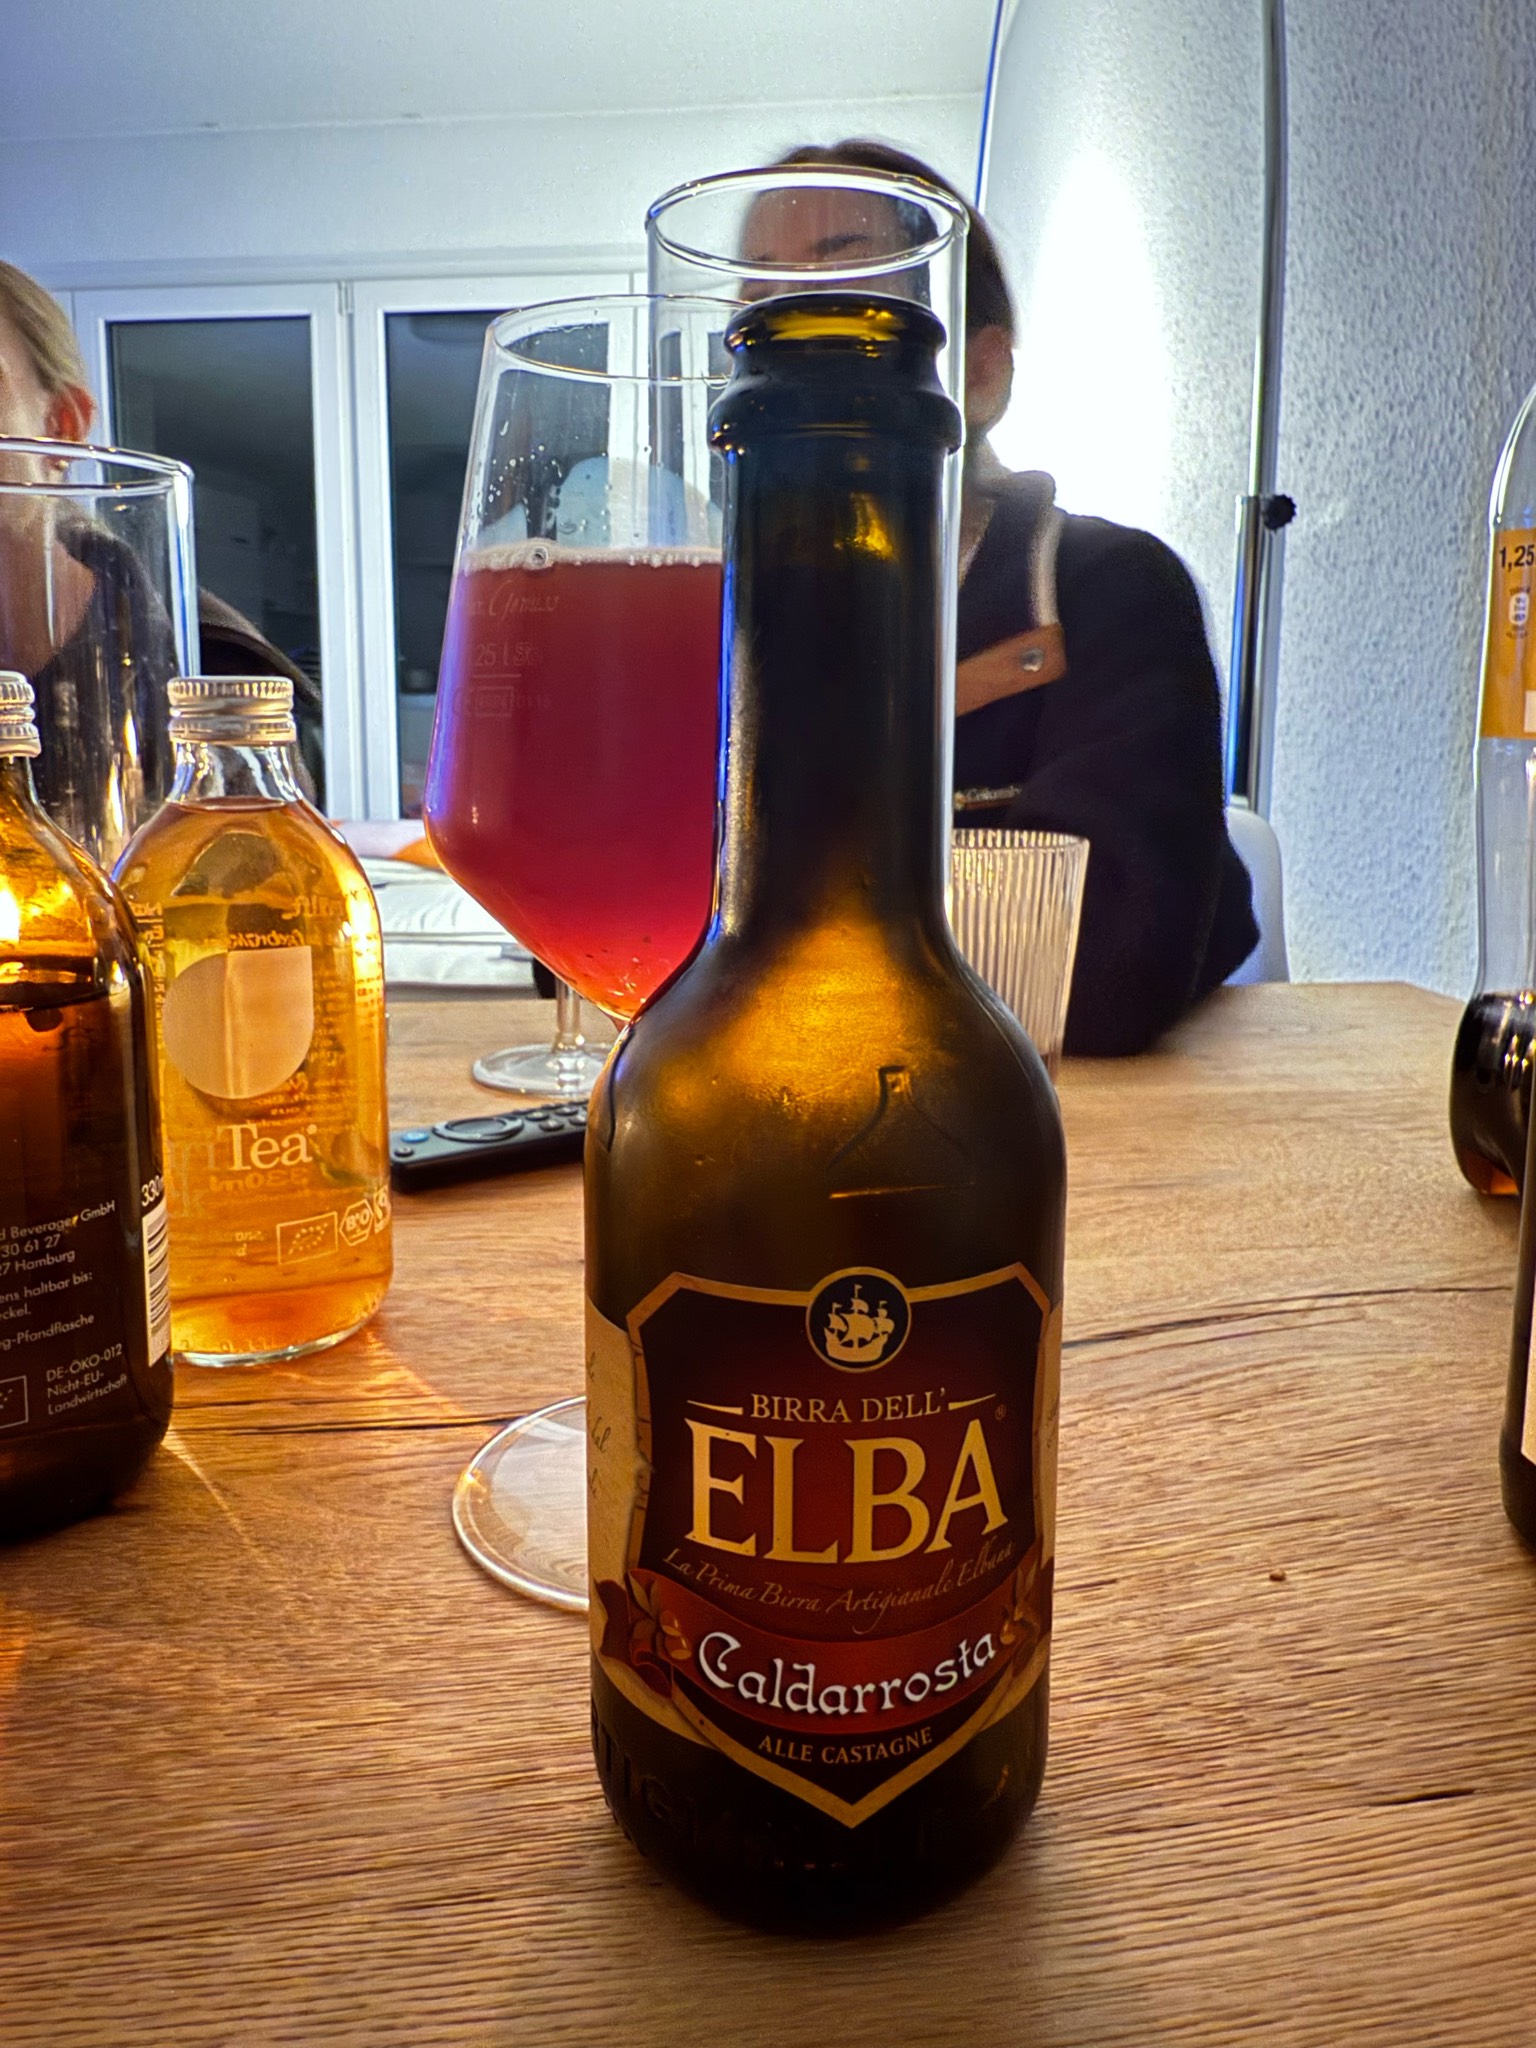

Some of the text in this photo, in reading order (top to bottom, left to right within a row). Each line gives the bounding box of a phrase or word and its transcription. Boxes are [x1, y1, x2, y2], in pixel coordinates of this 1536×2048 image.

[216, 1123, 313, 1171] Tea
[80, 1200, 116, 1221] GmbH
[15, 1250, 76, 1272] Hamburg
[24, 1239, 39, 1253] 61
[44, 1233, 61, 1248] 27
[24, 1278, 70, 1299] haltbar
[72, 1271, 93, 1285] bis:
[47, 1370, 104, 1398] Nicht-EU-
[48, 1374, 128, 1416] Landwirtschaft
[751, 1388, 947, 1424] BIRRA DELL'
[683, 1418, 1009, 1564] ELBA
[663, 1548, 694, 1577] La
[692, 1560, 759, 1601] Prima
[760, 1581, 823, 1611] Birra
[825, 1557, 955, 1634] Artigianale
[698, 1630, 998, 1716] Caldarrosta
[758, 1727, 933, 1765] ALLE CASTAGNE
